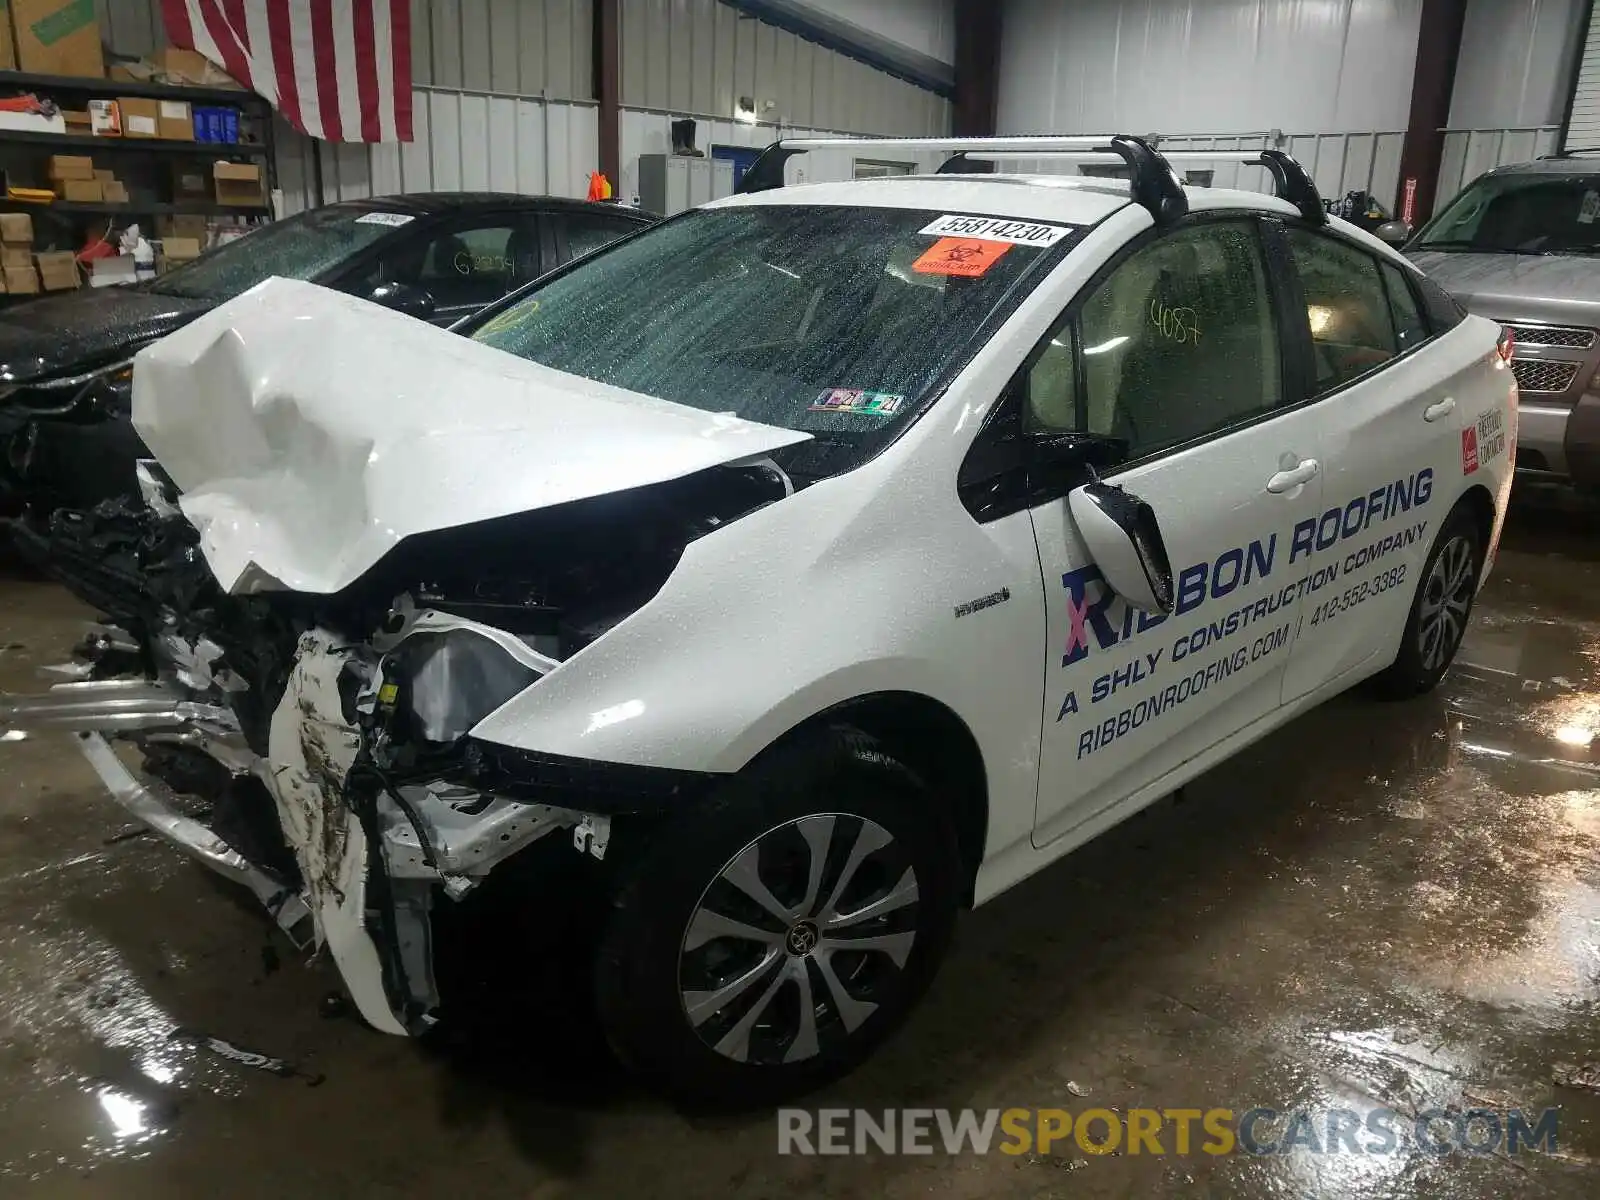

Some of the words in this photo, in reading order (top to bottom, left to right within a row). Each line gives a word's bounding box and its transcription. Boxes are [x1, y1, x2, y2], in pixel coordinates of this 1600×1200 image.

[1150, 298, 1203, 346] 4087
[1289, 467, 1433, 565] ROOFING
[1056, 691, 1079, 723] A
[1091, 647, 1164, 704] SHLY
[1172, 560, 1339, 663] CONSTRUCTION
[1343, 520, 1428, 576] COMPANY
[1077, 622, 1290, 761] RIBBONROOFING.COM
[1309, 563, 1408, 627] 412-552-3382
